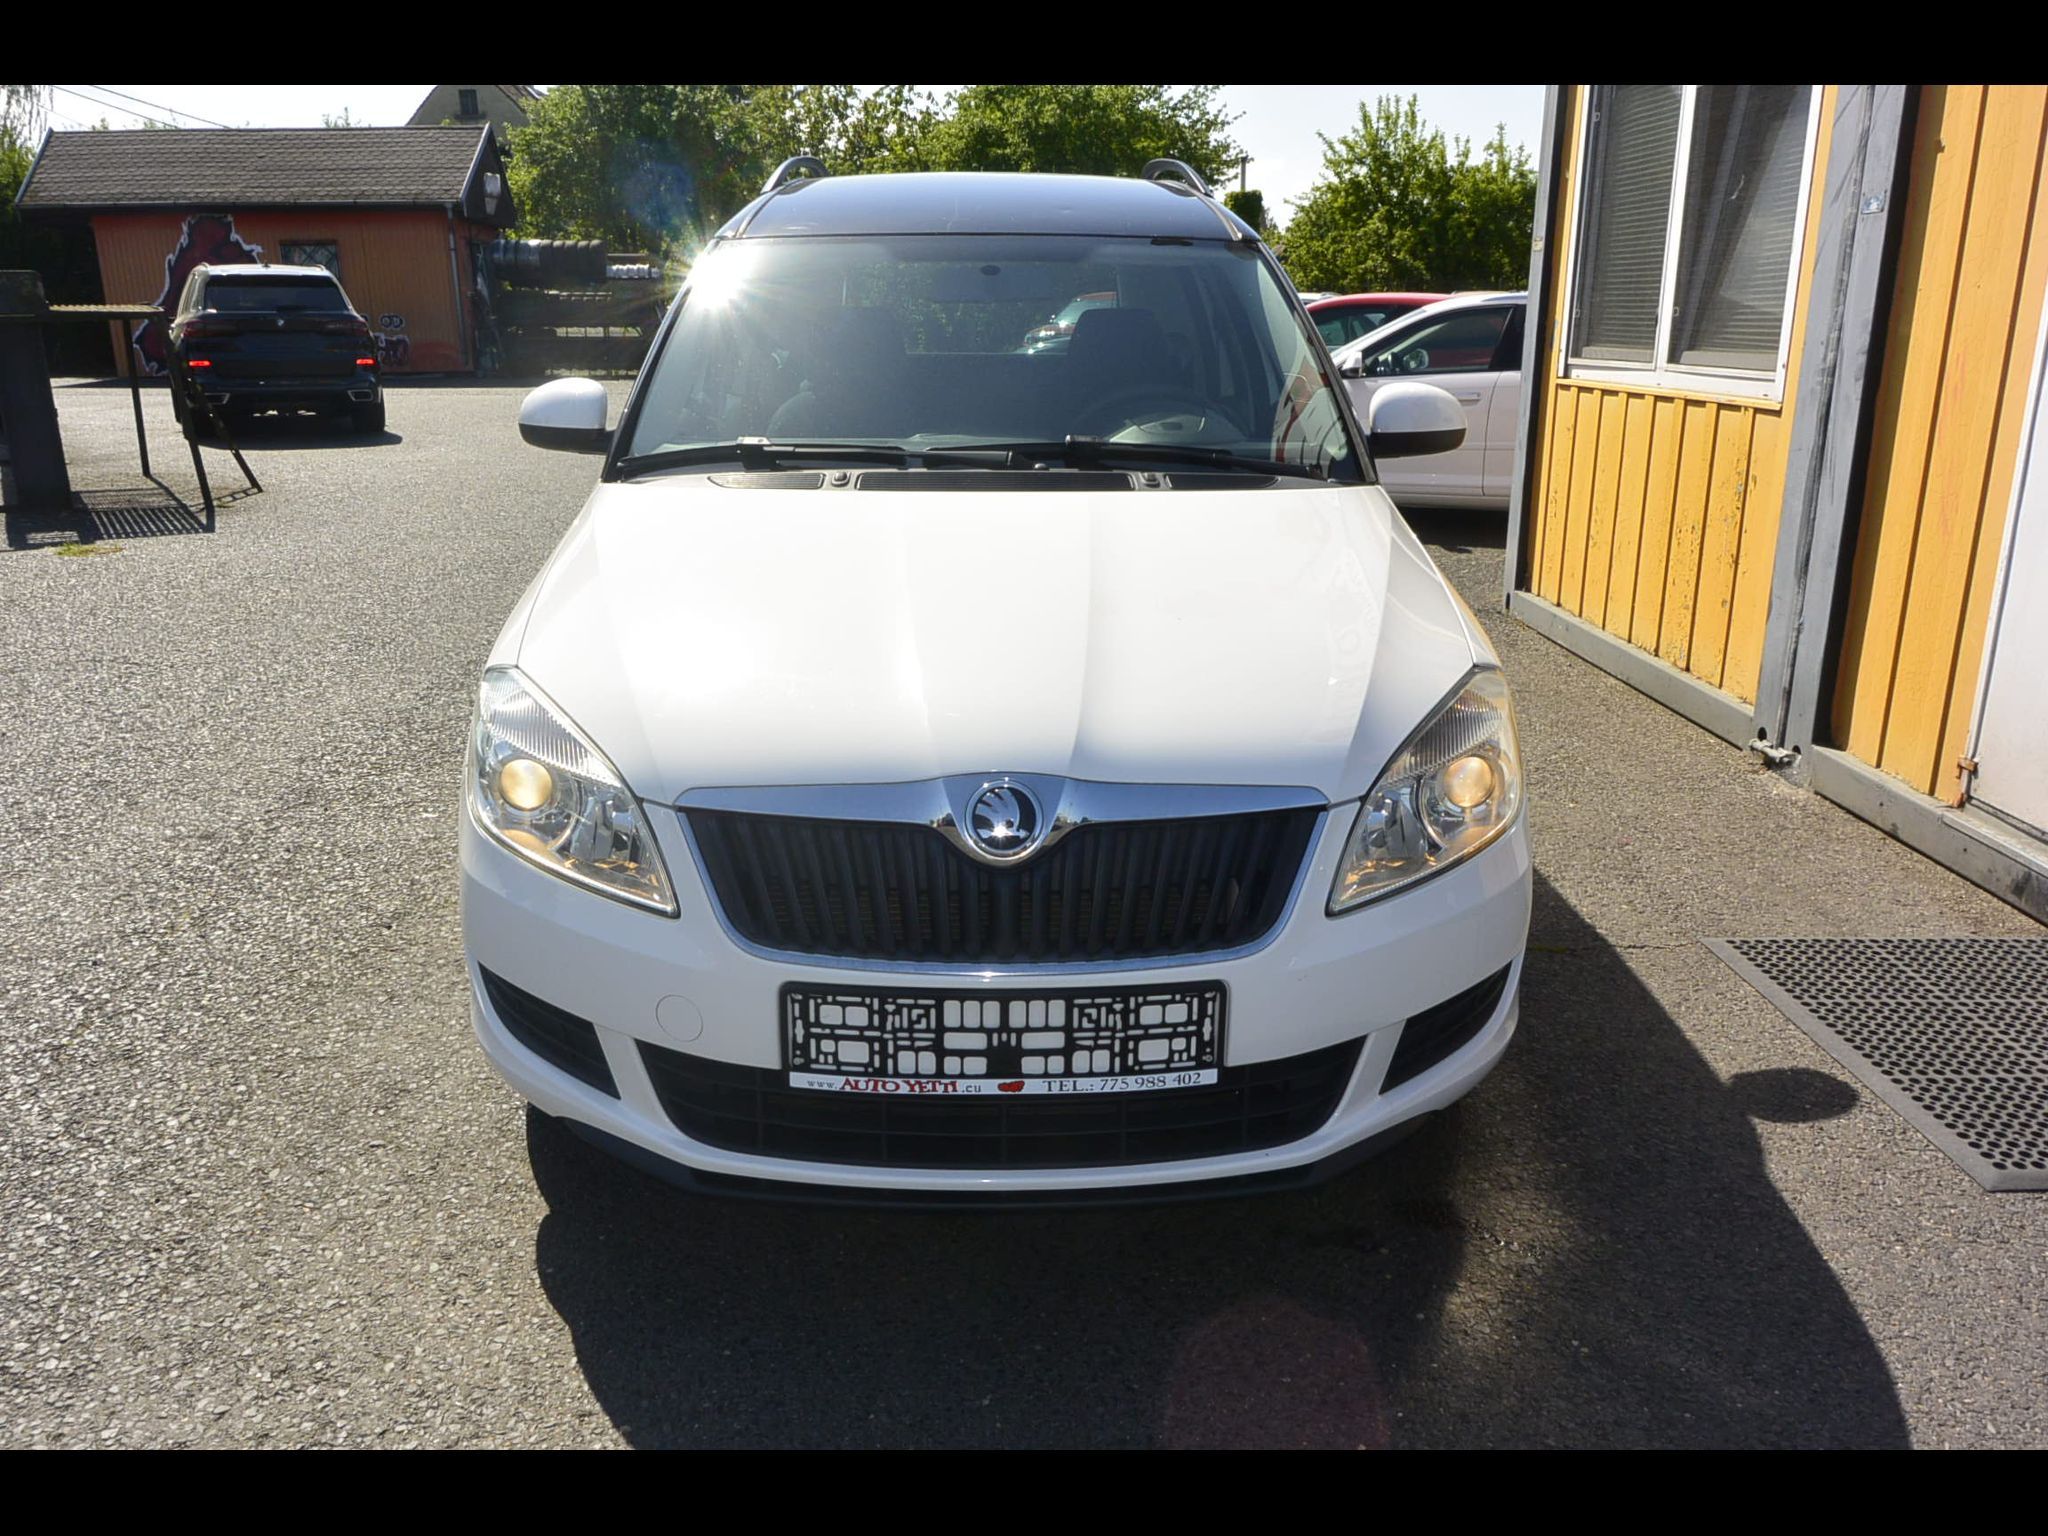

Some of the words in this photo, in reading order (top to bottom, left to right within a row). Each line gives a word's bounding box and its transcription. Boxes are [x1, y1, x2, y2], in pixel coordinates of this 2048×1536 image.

[1042, 1079, 1094, 1092] TEL.:
[1100, 1078, 1130, 1091] 775
[1135, 1075, 1167, 1088] 988
[1171, 1072, 1201, 1086] 402
